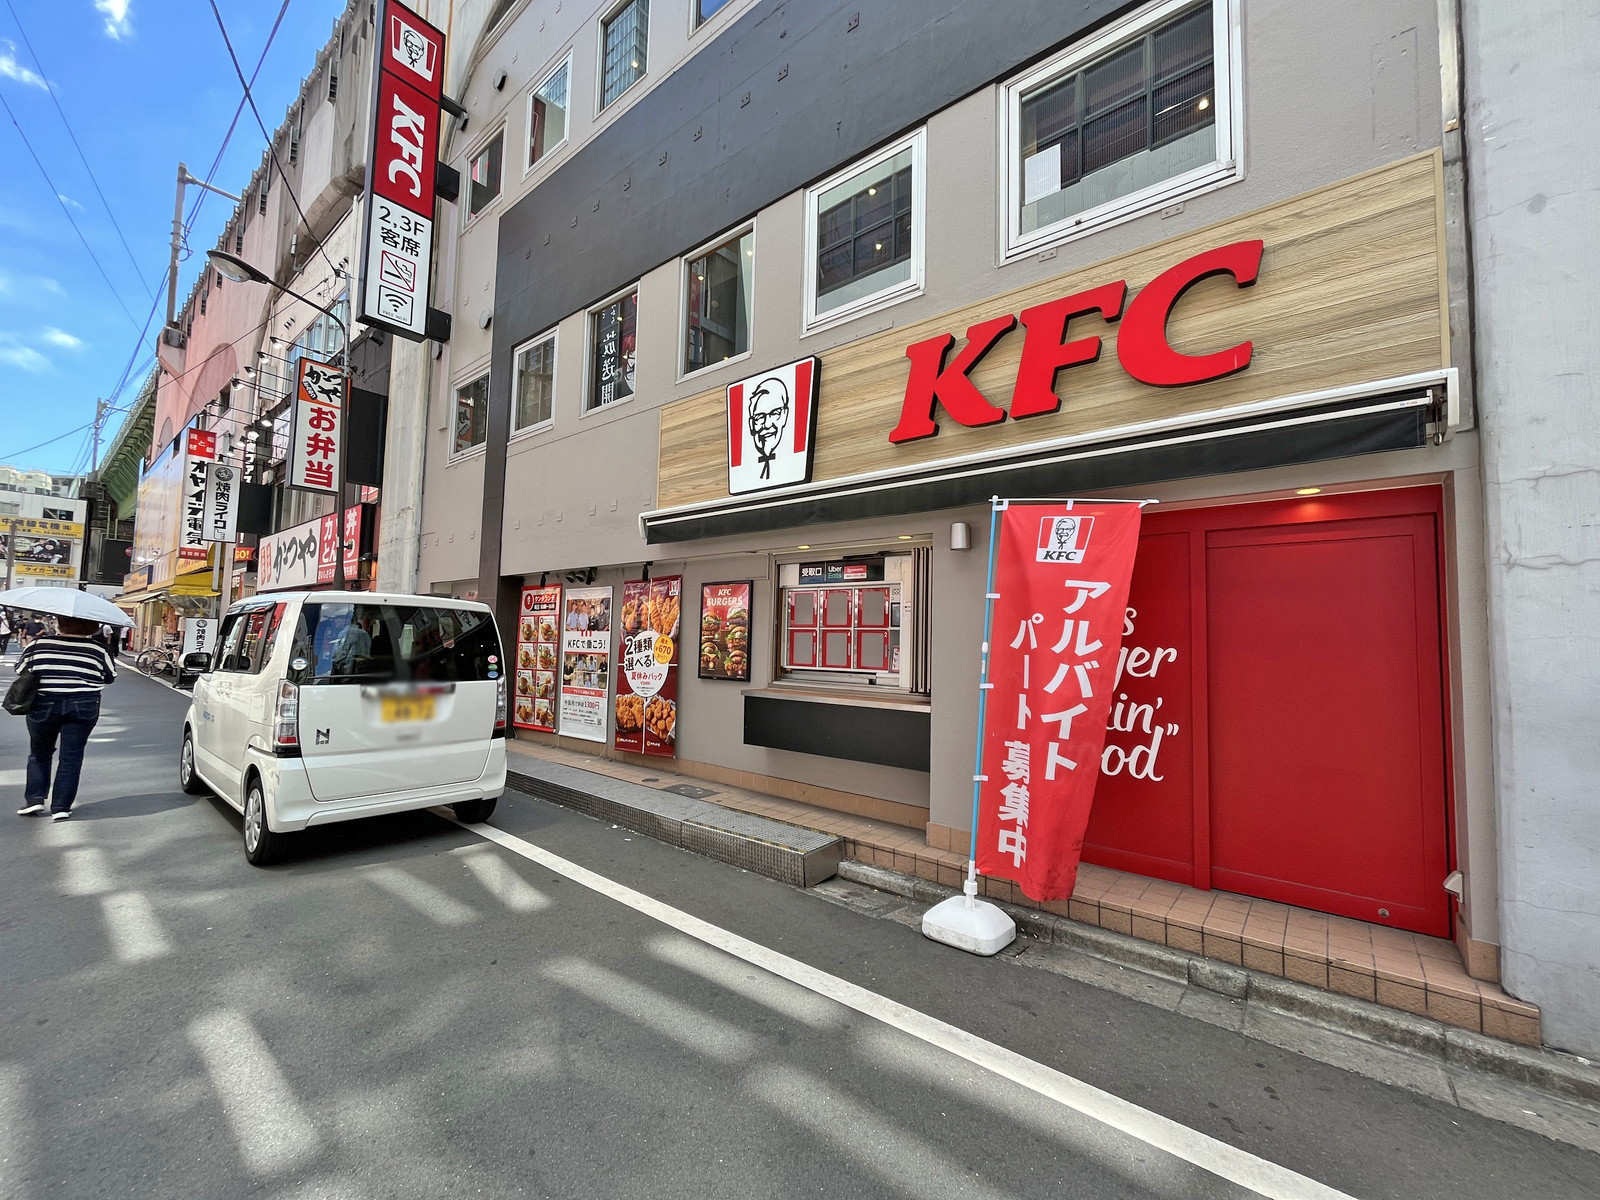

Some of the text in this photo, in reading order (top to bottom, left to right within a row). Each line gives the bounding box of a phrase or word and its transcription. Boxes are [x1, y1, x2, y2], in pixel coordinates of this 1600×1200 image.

[388, 93, 425, 198] KFC
[378, 205, 425, 236] 2,3F
[380, 226, 421, 257] 客席
[888, 239, 1264, 443] KFC
[303, 406, 338, 488] お弁当
[213, 481, 233, 530] 焼肉ライク
[324, 508, 357, 541] カ丼
[273, 527, 318, 585] かつや
[828, 565, 842, 573] Uber
[1043, 549, 1077, 562] KFC
[801, 567, 822, 577] 受取口
[706, 597, 743, 607] BURGERS
[718, 588, 732, 596] KFC
[567, 639, 606, 650] KFCで働こう!
[625, 637, 653, 656] 2種類
[625, 654, 655, 672] 選べる!
[631, 671, 663, 681] 夏休みパック
[1040, 579, 1112, 782] アルバイト
[997, 612, 1045, 869] パート 募集中
